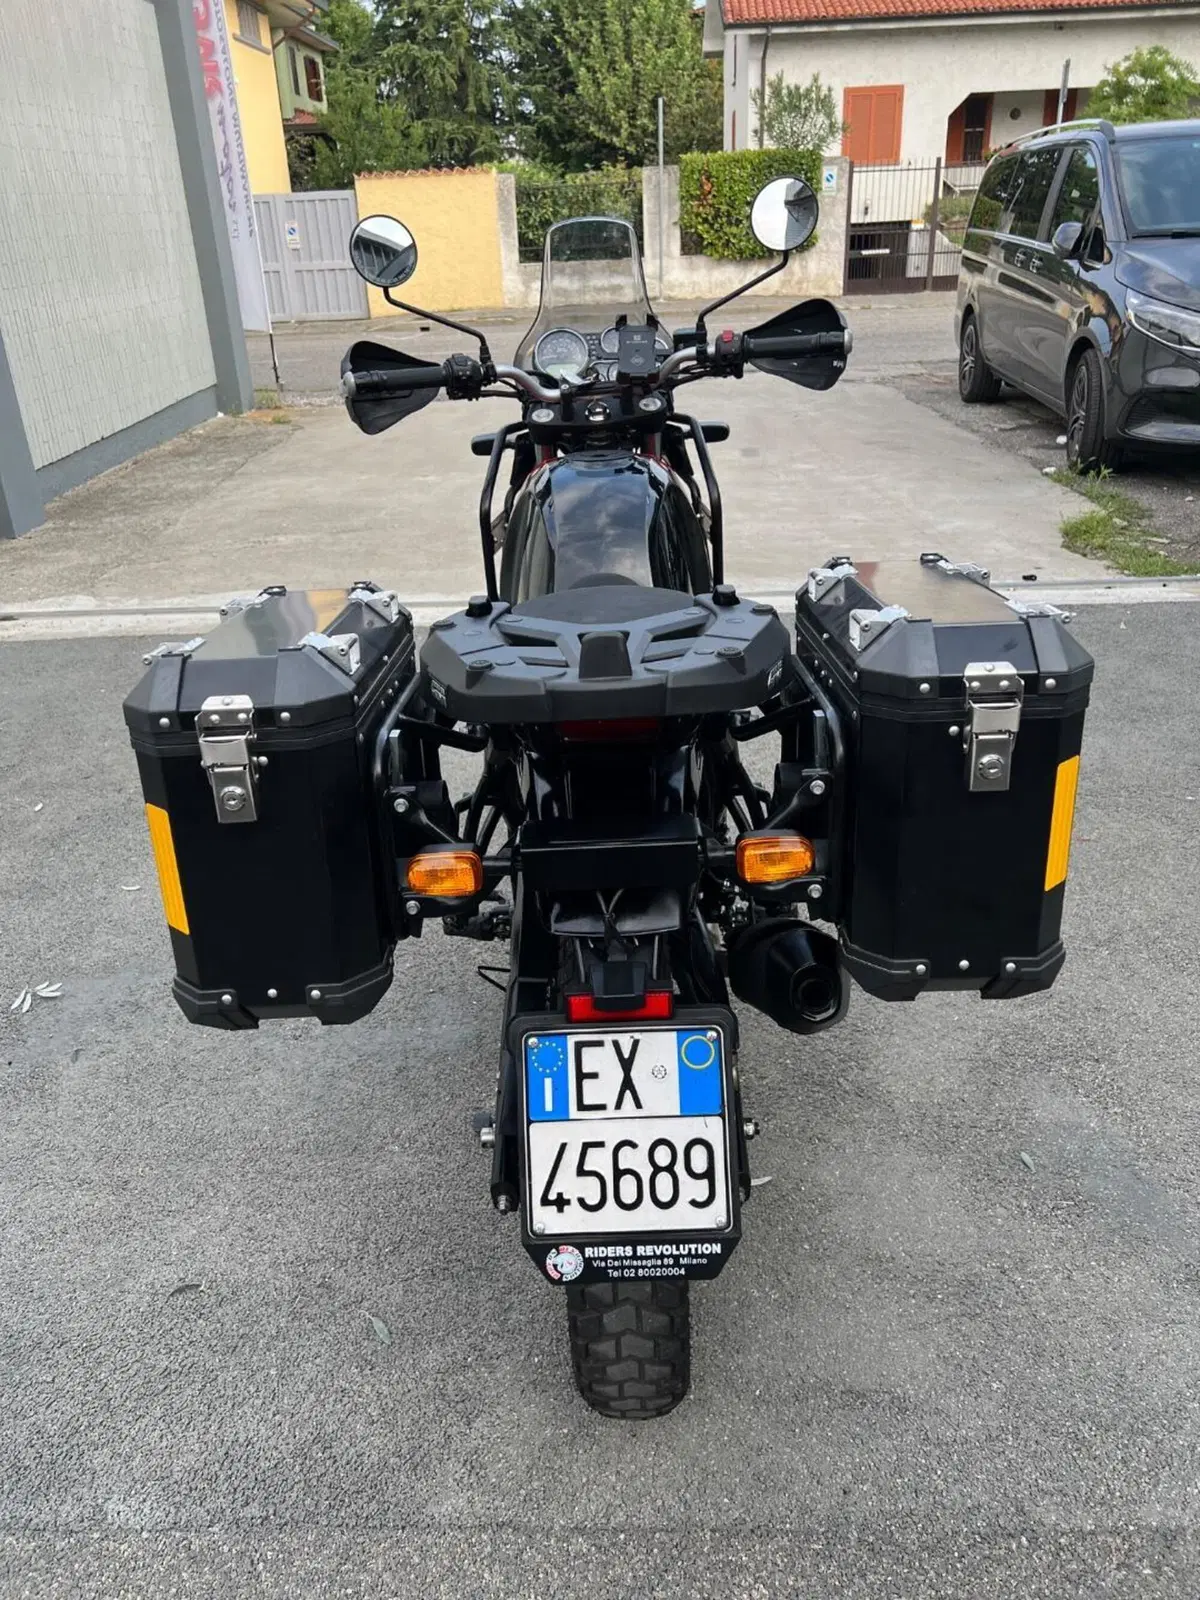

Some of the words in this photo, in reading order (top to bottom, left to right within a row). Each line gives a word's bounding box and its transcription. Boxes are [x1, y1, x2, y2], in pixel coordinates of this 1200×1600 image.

[573, 1038, 643, 1112] EX
[540, 1137, 717, 1214] 45689
[584, 1246, 633, 1258] RIDERS
[636, 1243, 722, 1256] REVOLUTION
[623, 1258, 662, 1267] Missaglia
[679, 1257, 708, 1265] Milano
[607, 1269, 622, 1278] Tel
[623, 1269, 636, 1277] 02
[637, 1267, 686, 1277] 80020004
